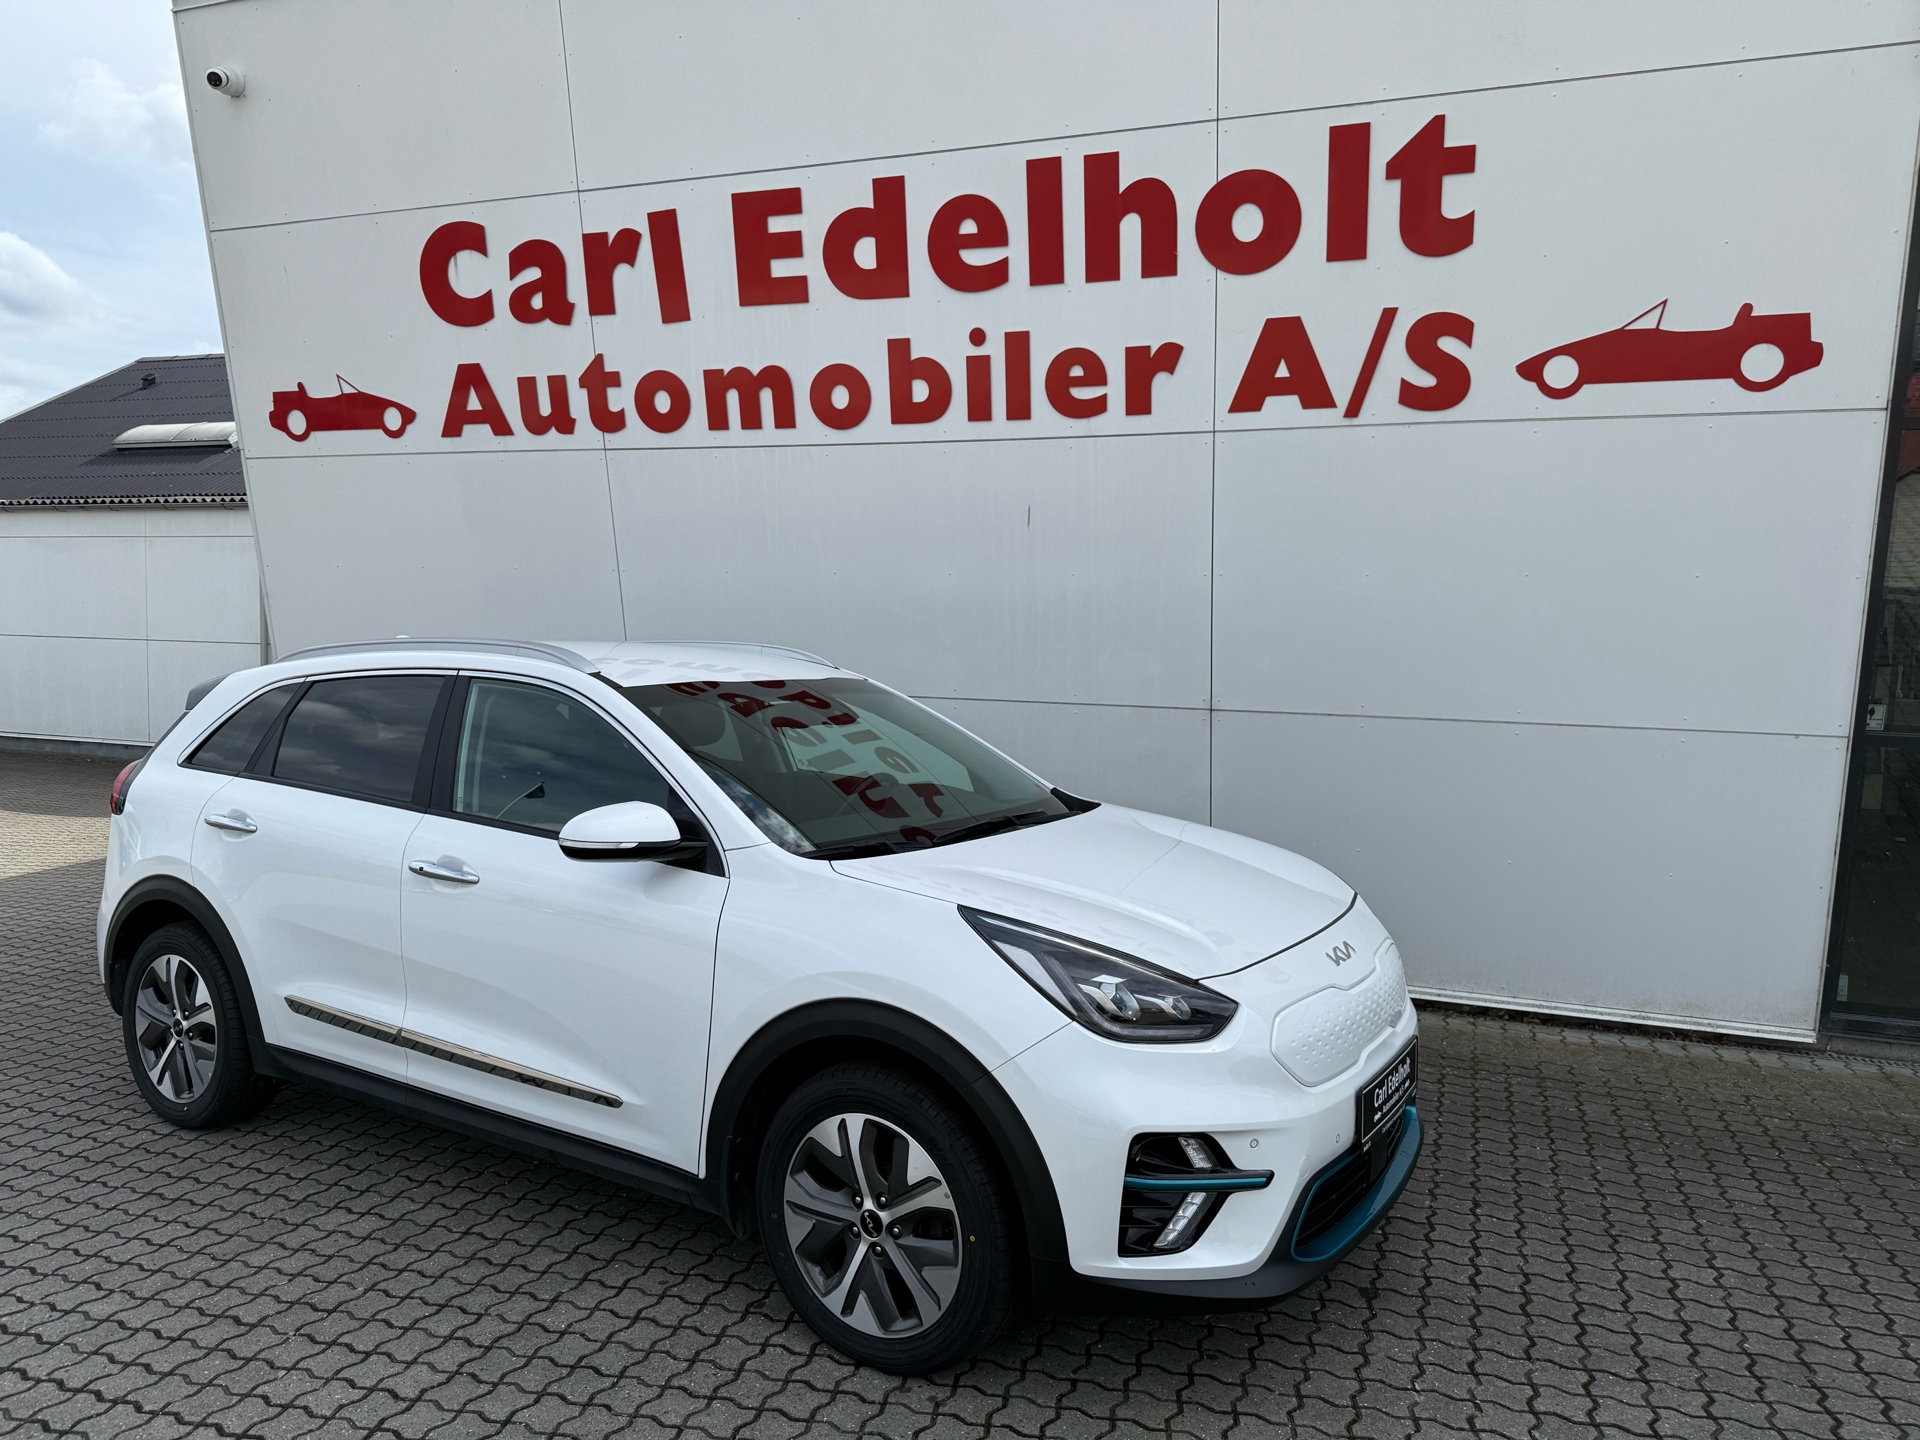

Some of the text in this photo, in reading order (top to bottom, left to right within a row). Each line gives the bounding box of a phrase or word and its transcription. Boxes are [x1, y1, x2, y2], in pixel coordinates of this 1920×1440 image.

[420, 115, 1475, 326] Carl Edelholt
[442, 308, 1473, 437] Automobiler A/S
[1374, 1079, 1388, 1108] Carl
[1388, 1056, 1410, 1094] Edelholt
